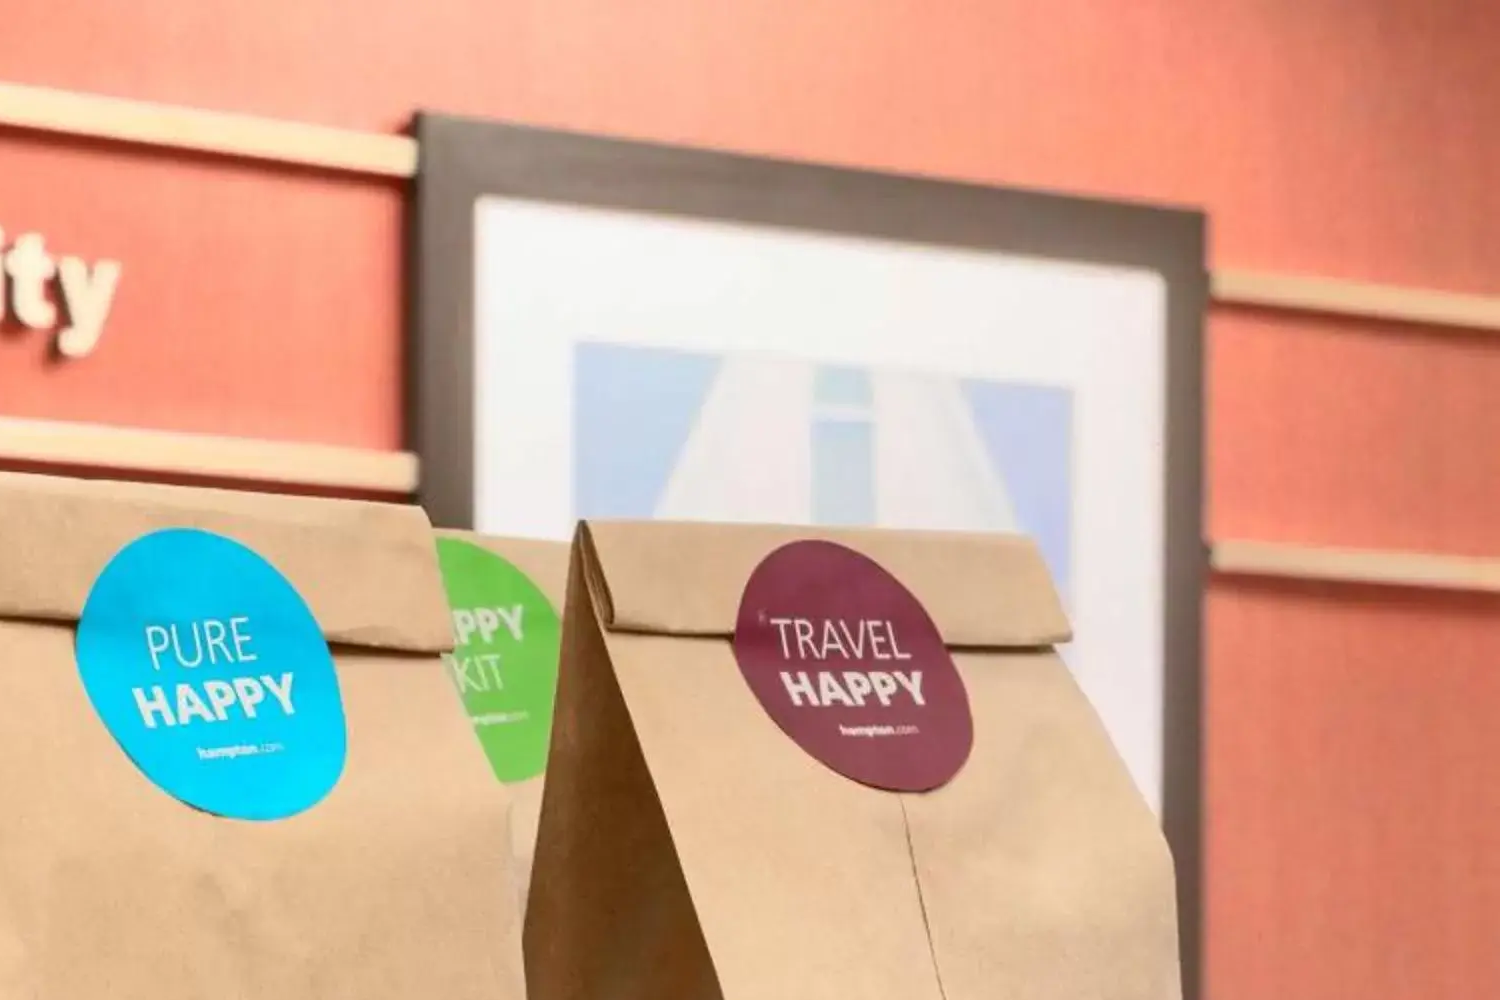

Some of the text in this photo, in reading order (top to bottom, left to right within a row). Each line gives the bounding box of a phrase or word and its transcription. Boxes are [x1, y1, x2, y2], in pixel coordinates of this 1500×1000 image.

[145, 616, 258, 671] PURE
[452, 603, 525, 645] PPY
[769, 617, 913, 660] TRAVEL
[450, 653, 505, 694] KIT
[780, 671, 926, 707] HAPPY
[132, 672, 295, 729] HAPPY
